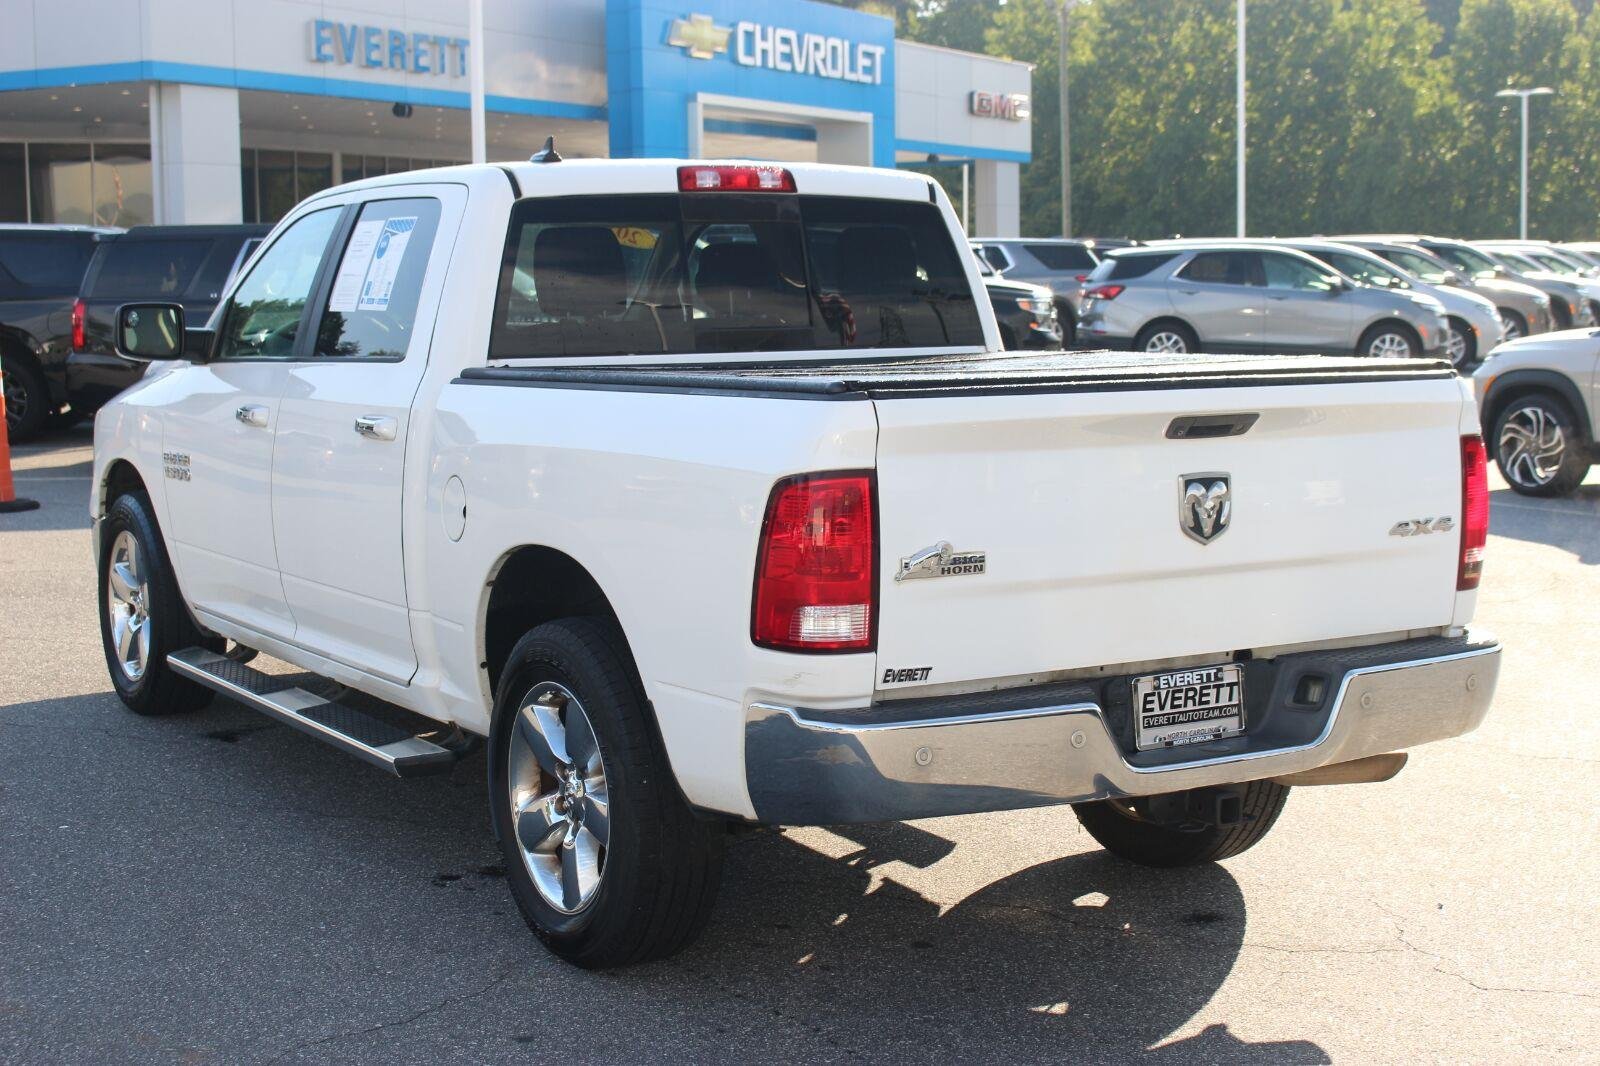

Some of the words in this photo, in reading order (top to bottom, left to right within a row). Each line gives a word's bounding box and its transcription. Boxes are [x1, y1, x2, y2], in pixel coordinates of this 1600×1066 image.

[313, 19, 471, 77] EVERETT
[737, 20, 885, 85] CHEVROLET
[940, 564, 984, 575] HORN
[882, 666, 933, 684] EVERETT
[1159, 668, 1218, 689] EVERETT
[1142, 681, 1239, 714] EVERETT
[1143, 706, 1239, 728] EVERETTAUTOTEAM.COM
